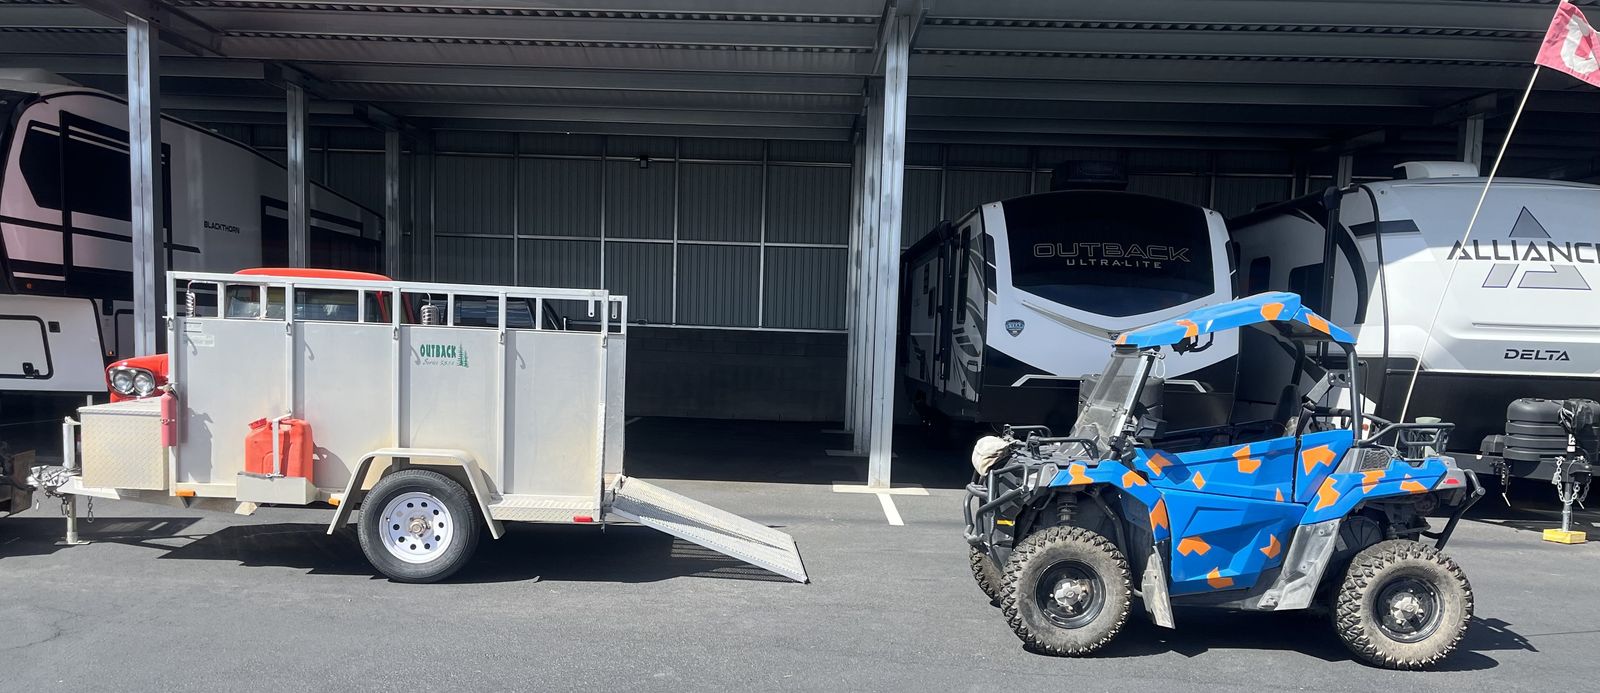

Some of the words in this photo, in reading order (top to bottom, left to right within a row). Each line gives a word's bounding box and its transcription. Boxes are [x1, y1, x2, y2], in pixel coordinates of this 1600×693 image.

[203, 220, 240, 235] BLACKTHORN
[1033, 242, 1192, 263] OUTBACK
[1447, 239, 1600, 264] ALLIANC
[1066, 258, 1162, 269] ULTRA-LITE
[420, 343, 457, 359] OUTBACK
[1504, 348, 1571, 361] DELTA
